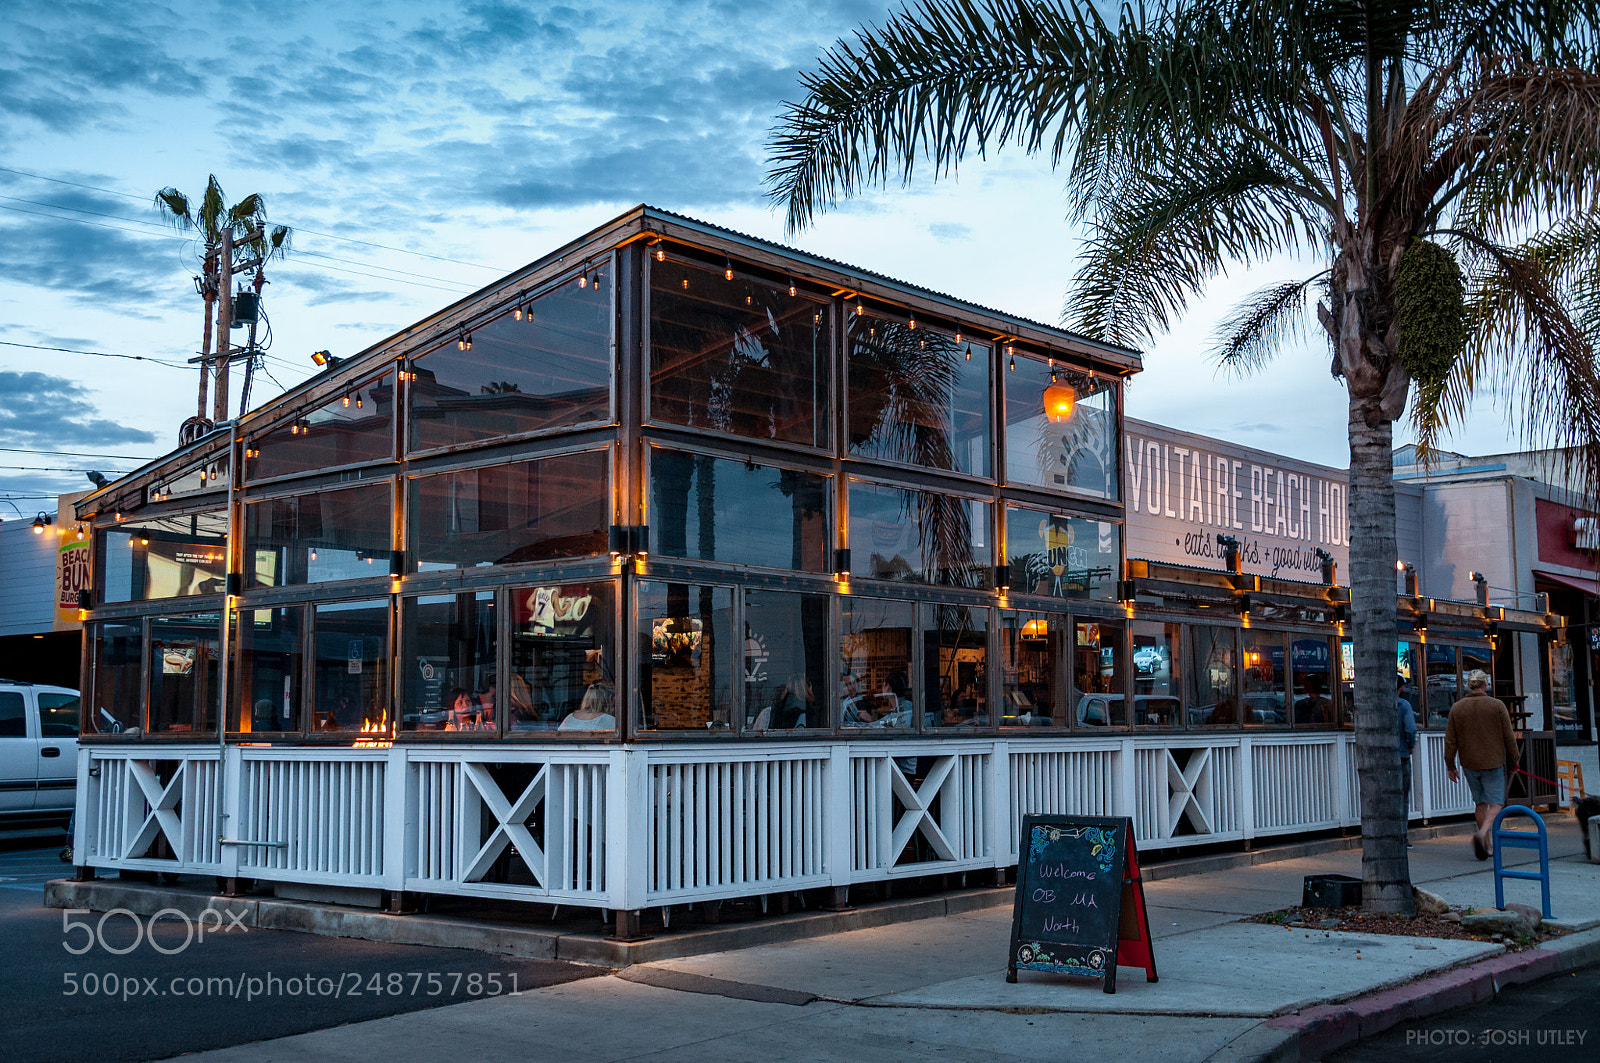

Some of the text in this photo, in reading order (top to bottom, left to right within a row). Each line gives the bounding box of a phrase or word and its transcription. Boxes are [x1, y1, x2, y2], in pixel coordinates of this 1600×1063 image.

[1126, 434, 1350, 547] VOLTAIRE BEACH HOU
[1271, 545, 1301, 577] good
[60, 591, 79, 603] BURG
[1039, 862, 1096, 880] Welcome
[1032, 888, 1056, 903] OB
[1042, 915, 1080, 934] North
